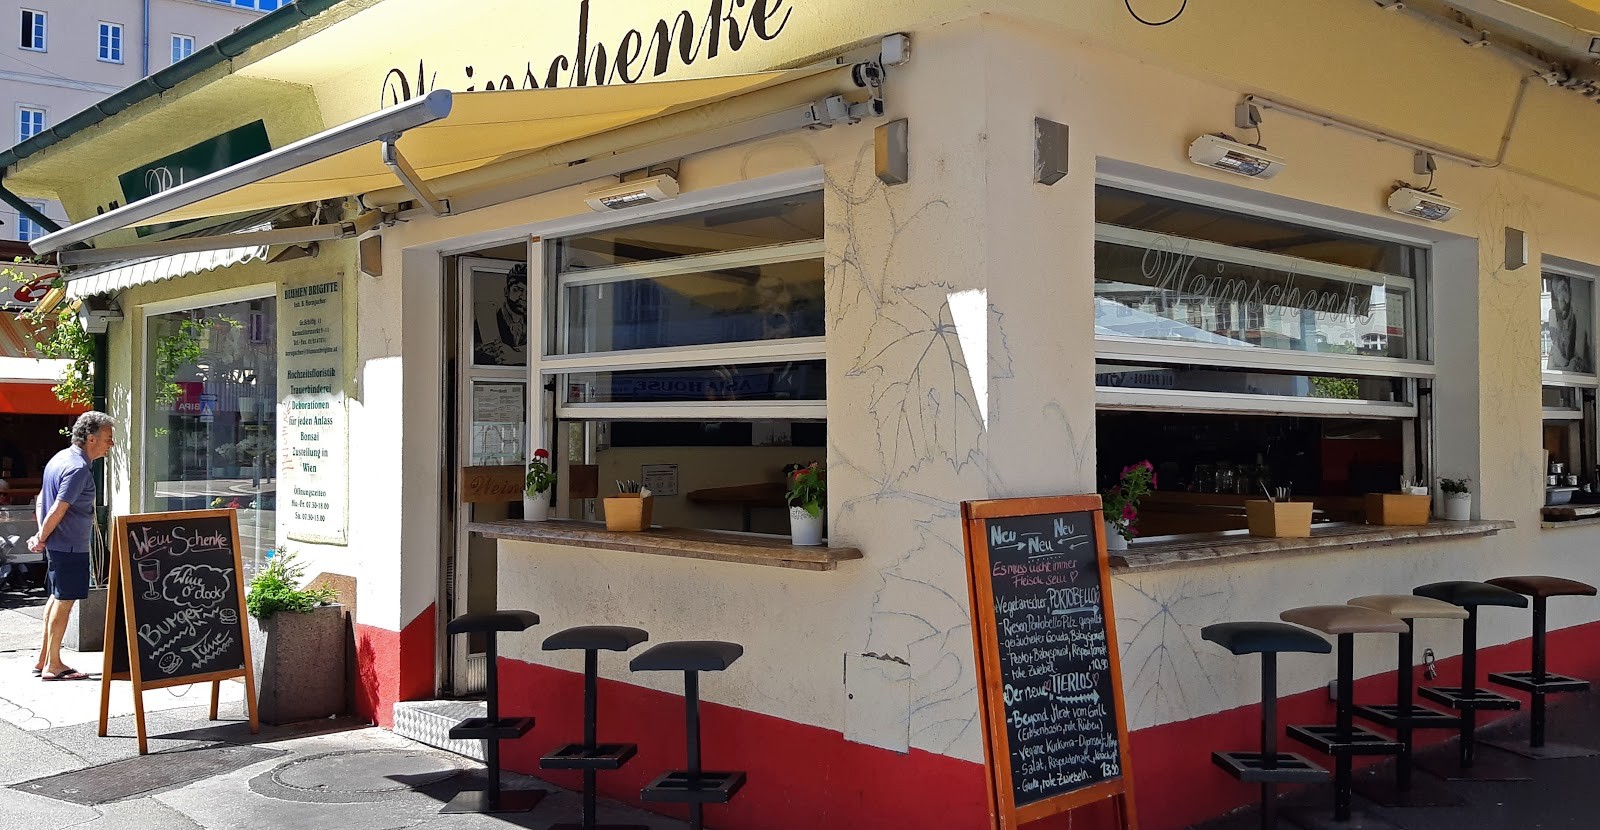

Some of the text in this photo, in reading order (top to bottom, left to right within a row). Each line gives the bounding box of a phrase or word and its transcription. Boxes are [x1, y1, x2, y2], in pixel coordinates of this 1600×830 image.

[1142, 236, 1375, 326] Weinschenke
[284, 282, 338, 300] BLUMEN BRIGITTE
[287, 367, 336, 380] Hochzeitsfloristik
[290, 384, 332, 395] Trauerbinderei
[292, 400, 330, 410] Dekorationen
[288, 416, 333, 428] für jeden Anlass
[300, 432, 320, 441] Bonsai
[292, 446, 328, 459] Zustellung in
[302, 462, 317, 473] Wien
[990, 518, 1074, 546] Neu Neu
[130, 526, 229, 556] Wein Schenke
[1028, 536, 1054, 554] Neu
[992, 560, 1078, 576] Es muss nicht immer
[169, 567, 206, 588] Wine
[1012, 573, 1066, 588] Fleisch sein
[138, 607, 204, 647] Burger
[1060, 614, 1078, 630] Pilz
[180, 629, 230, 660] Time
[1010, 652, 1029, 666] Pesto
[1012, 666, 1027, 680] rote
[1024, 686, 1048, 701] neue
[1012, 708, 1049, 730] Beyond
[1050, 702, 1070, 723] Meat
[1088, 703, 1107, 718] Grill
